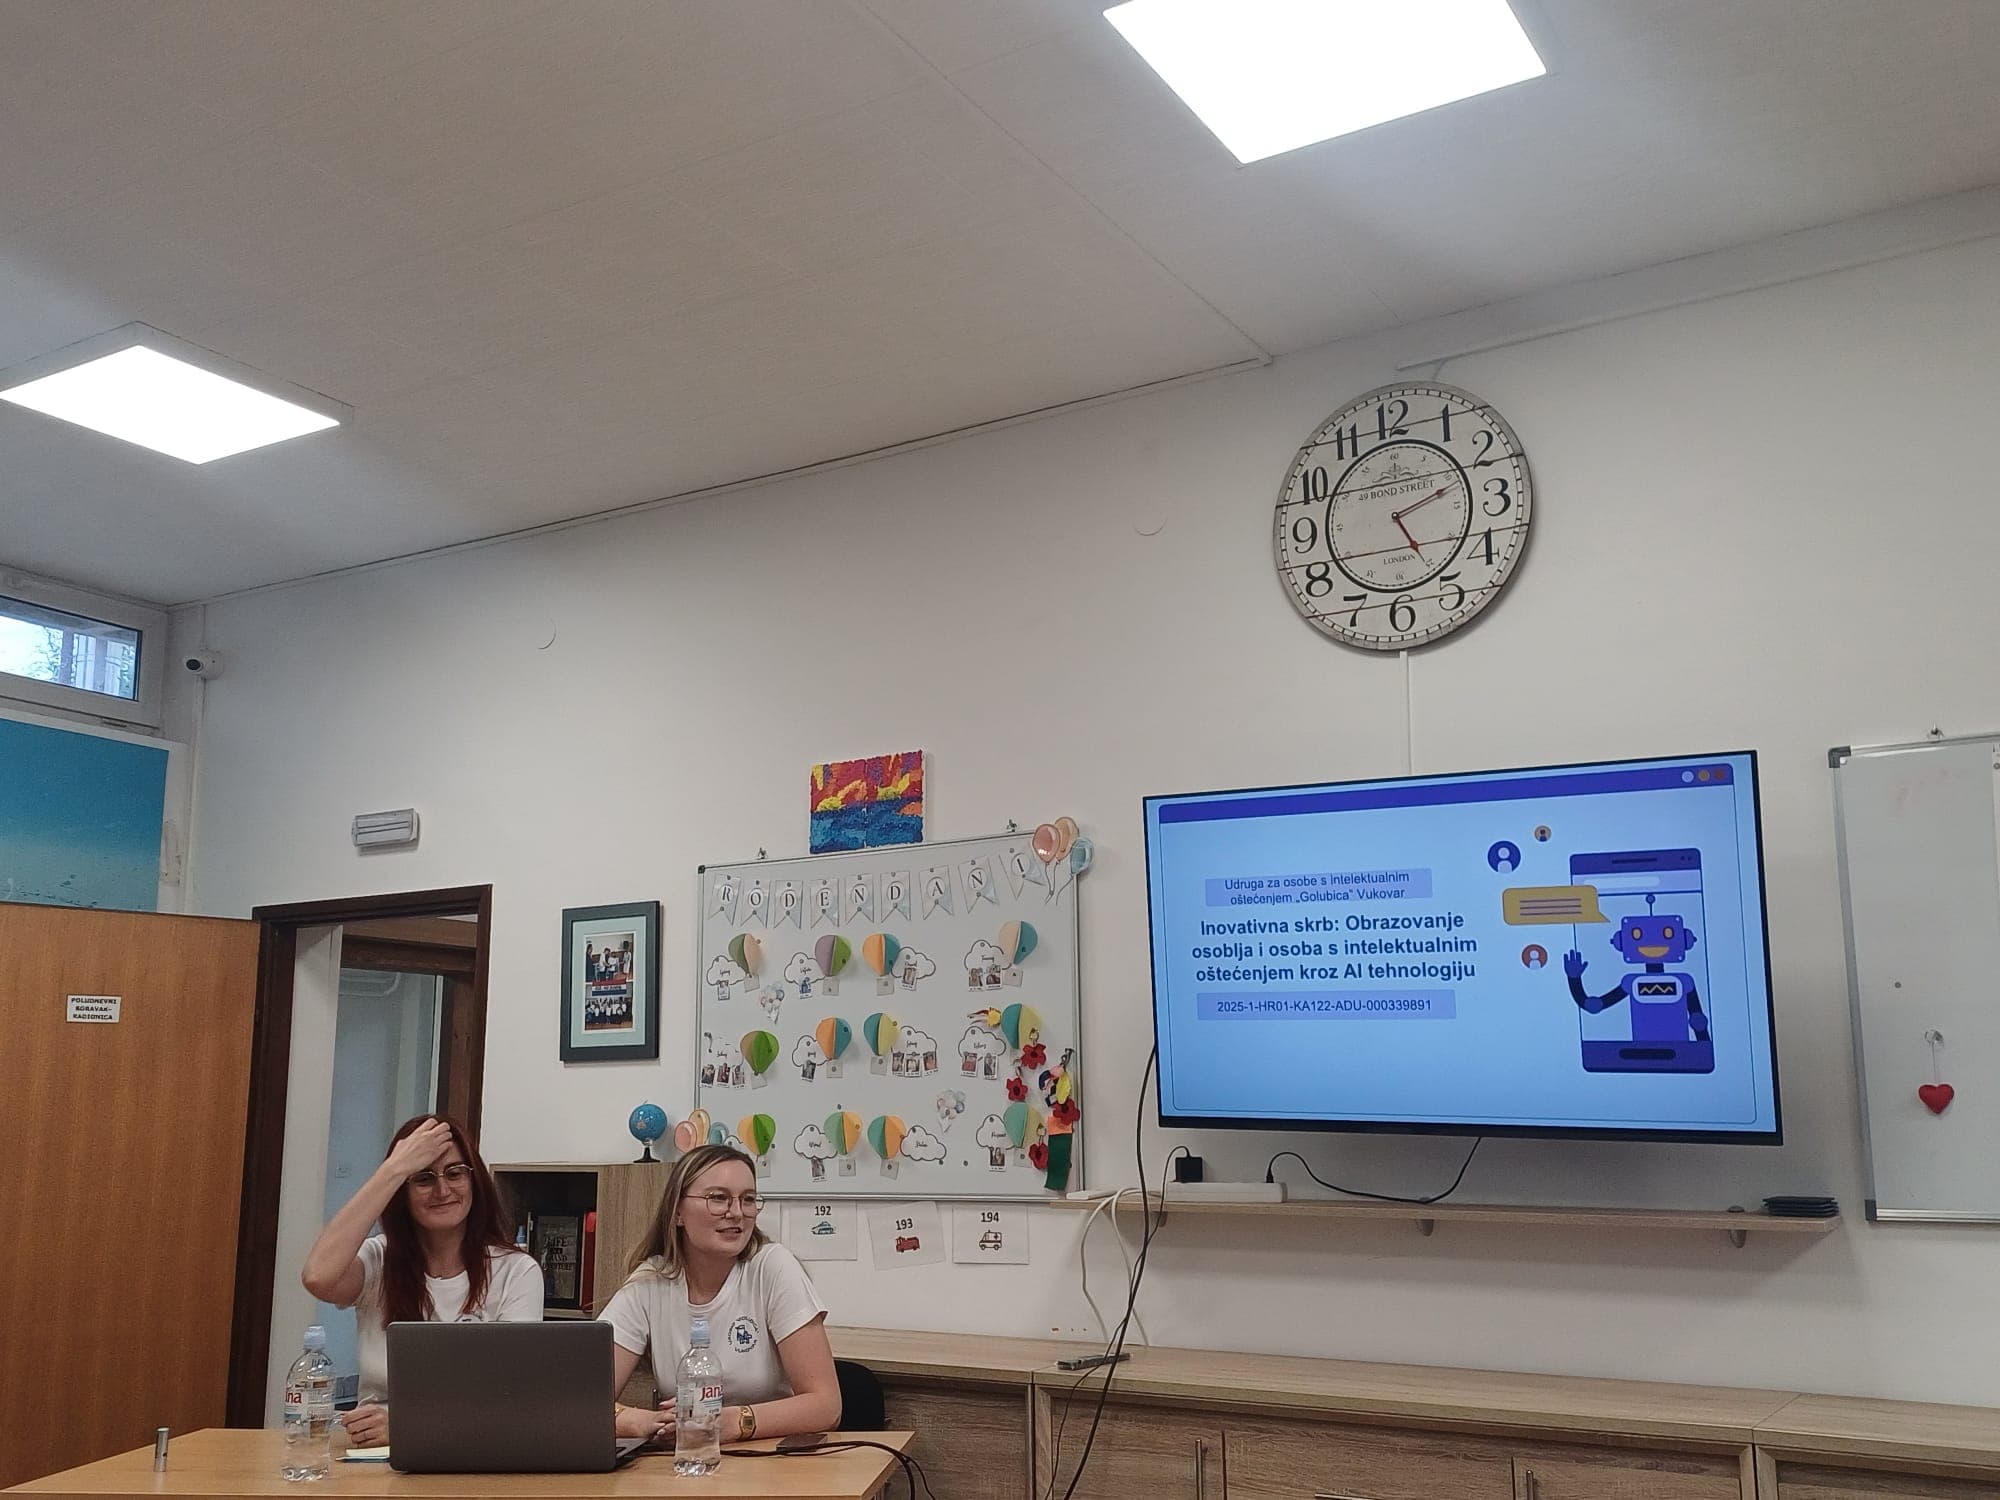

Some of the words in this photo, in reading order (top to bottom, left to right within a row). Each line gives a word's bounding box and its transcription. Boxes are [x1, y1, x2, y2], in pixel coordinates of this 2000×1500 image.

[1377, 400, 1409, 440] 12
[1440, 404, 1452, 442] 1
[1335, 423, 1359, 460] 11
[1471, 430, 1494, 469] 2
[1301, 466, 1328, 506] 10
[1370, 486, 1398, 500] BOND
[1399, 480, 1435, 493] STREET
[1482, 478, 1511, 516] 3
[1292, 517, 1318, 553] 9
[1466, 527, 1500, 566] 4
[1383, 553, 1416, 565] LONDON
[1305, 562, 1334, 597] 8
[1439, 571, 1465, 611] 5
[1343, 593, 1368, 627] 7
[1389, 595, 1417, 632] 6
[1225, 879, 1264, 892] Udruga
[1267, 879, 1281, 889] za
[1283, 876, 1318, 888] osobe
[1320, 877, 1327, 886] s
[1330, 872, 1410, 886] intelektualnim
[1230, 893, 1293, 906] oštećenjem
[1356, 888, 1405, 900] Vukovar
[1201, 920, 1289, 936] Inovativna
[1294, 917, 1340, 933] skrb:
[1345, 912, 1465, 932] Obrazovanje
[1192, 942, 1253, 960] osoblja
[1258, 942, 1263, 957] i
[1268, 940, 1323, 957] osoba
[1328, 943, 1339, 955] s
[1344, 937, 1478, 955] intelektualnim
[1196, 965, 1294, 984] oštećenjem
[1300, 964, 1339, 979] kroz
[1344, 963, 1363, 979] AI
[1368, 961, 1476, 981] tehnologiju
[1217, 999, 1432, 1013] 2025-1-HR01-KA122-ADU-000339891
[814, 1206, 832, 1216] 192
[895, 1218, 914, 1231] 193
[981, 1212, 1000, 1223] 194
